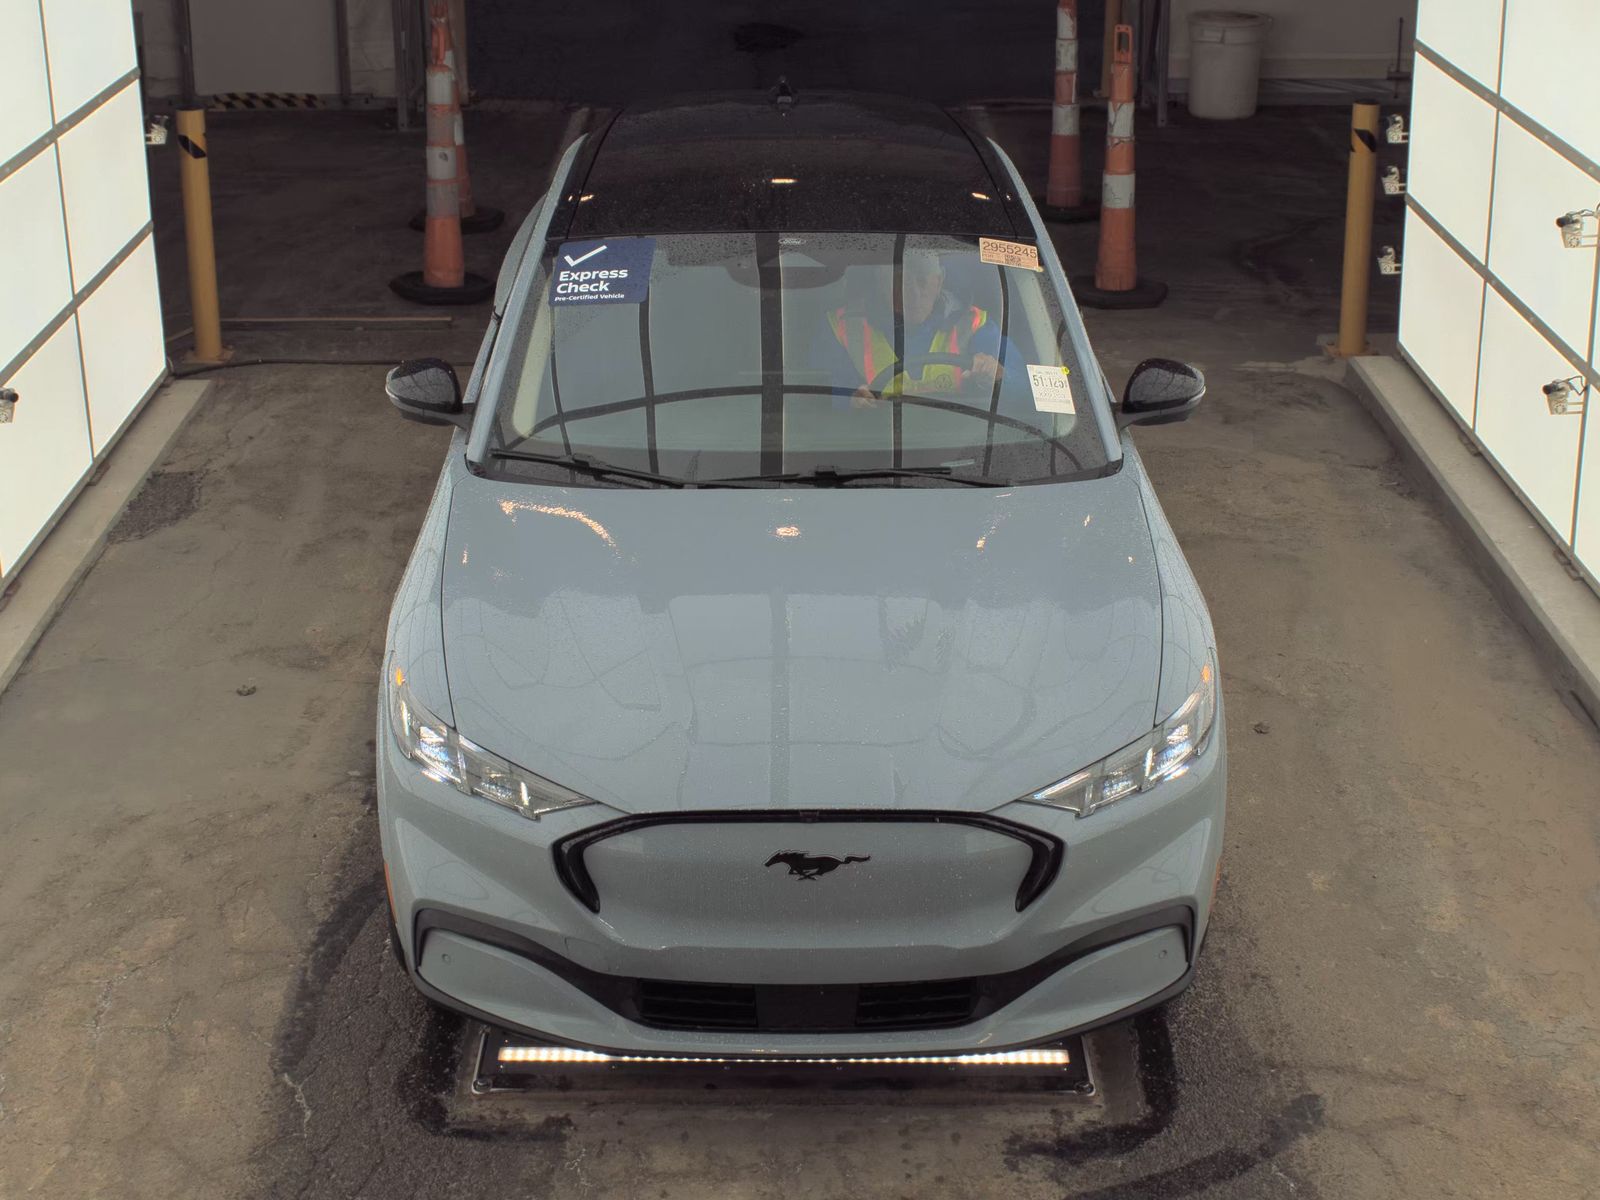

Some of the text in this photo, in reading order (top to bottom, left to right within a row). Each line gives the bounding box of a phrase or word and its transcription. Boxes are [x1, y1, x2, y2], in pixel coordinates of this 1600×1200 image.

[983, 241, 1037, 258] 2955245
[559, 270, 628, 282] Express
[557, 281, 610, 294] Check
